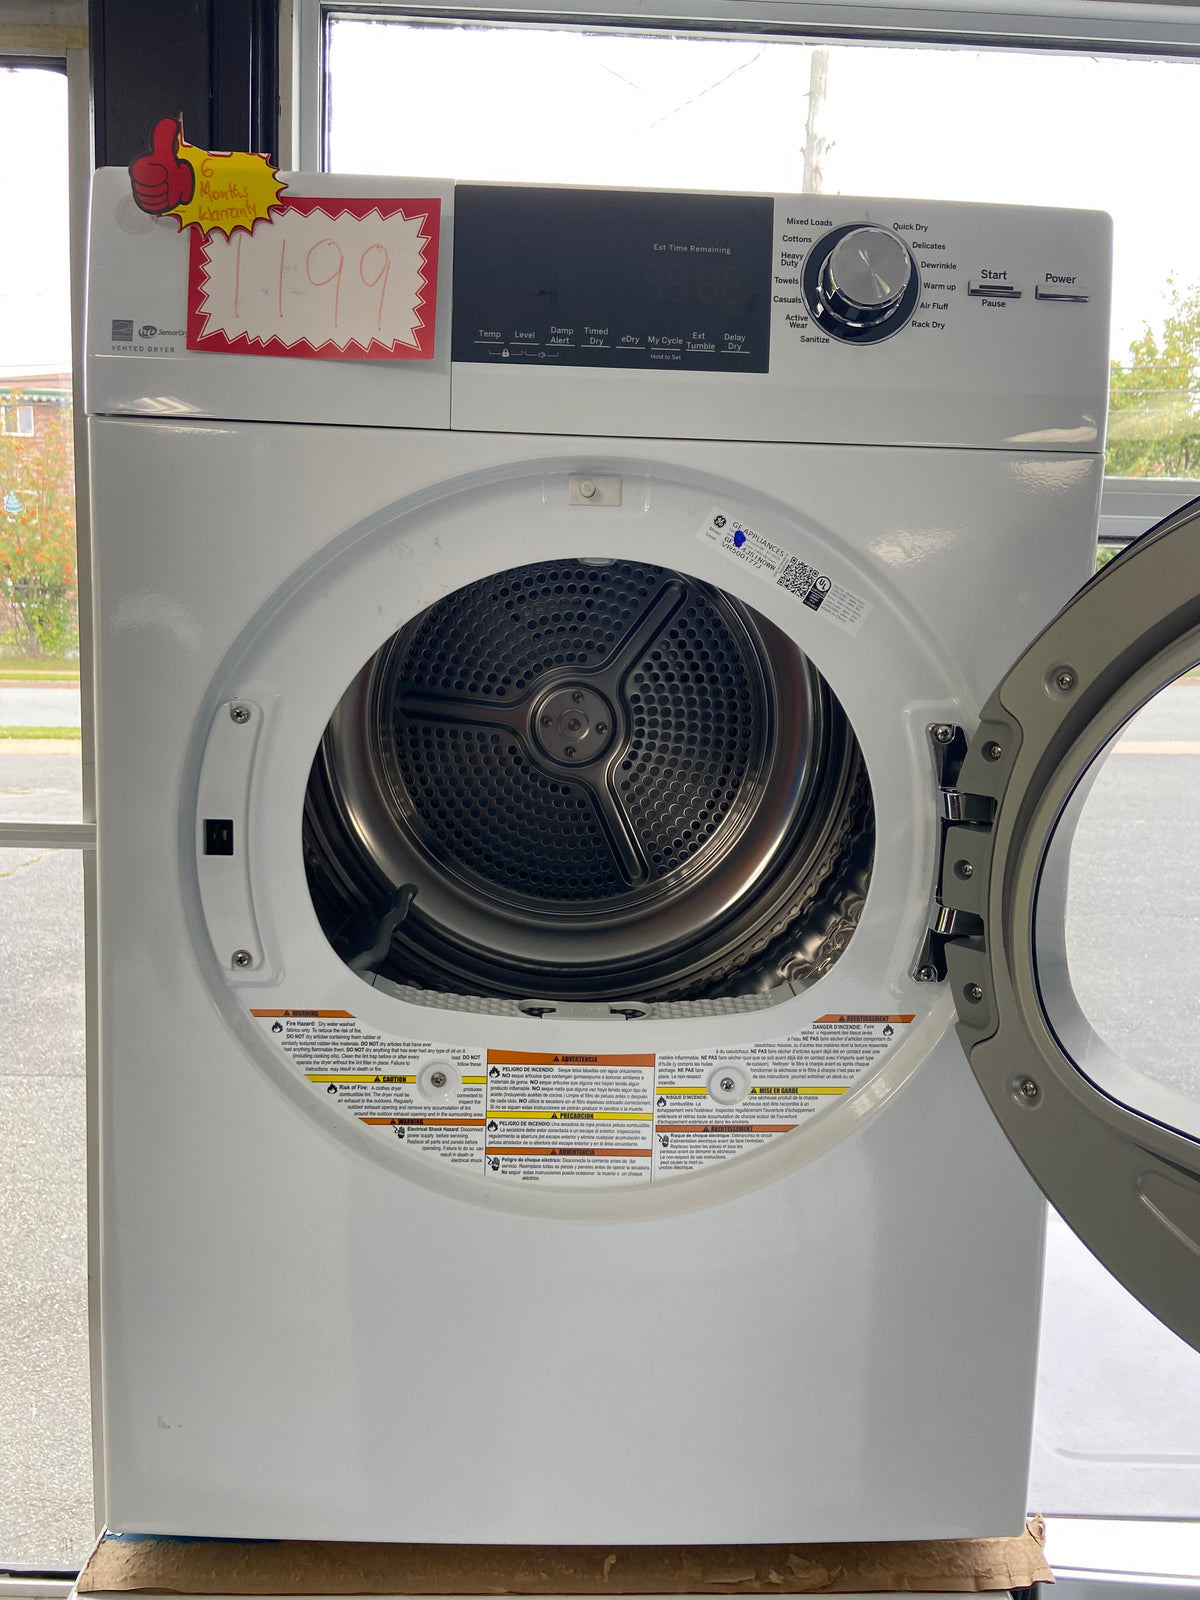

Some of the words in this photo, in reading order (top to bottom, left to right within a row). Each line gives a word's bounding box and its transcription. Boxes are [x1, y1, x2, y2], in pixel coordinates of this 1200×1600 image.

[200, 158, 215, 178] 6
[200, 181, 248, 202] Months
[198, 201, 257, 222] Warranty
[916, 224, 928, 232] Dry
[782, 235, 812, 243] Cottons
[668, 244, 688, 252] Time
[690, 245, 731, 255] Remaining
[912, 242, 945, 250] Delicates
[781, 252, 804, 260] Heavy
[781, 259, 798, 268] Duty
[981, 269, 1007, 280] Start
[1046, 273, 1076, 284] Power
[924, 282, 945, 290] Warm
[982, 299, 1006, 307] Pause
[551, 326, 574, 334] Damp
[932, 322, 945, 330] Dry
[479, 330, 501, 339] Temp
[584, 327, 608, 335] Timed
[550, 336, 570, 344] Alert
[589, 337, 604, 346] Dry
[622, 335, 640, 344] eDry
[648, 336, 659, 344] My
[662, 336, 683, 345] Cycle
[724, 333, 746, 342] Delay
[687, 342, 715, 350] Tumble
[728, 343, 742, 351] Dry
[744, 528, 785, 557] APPLIANCES
[819, 579, 826, 590] UL
